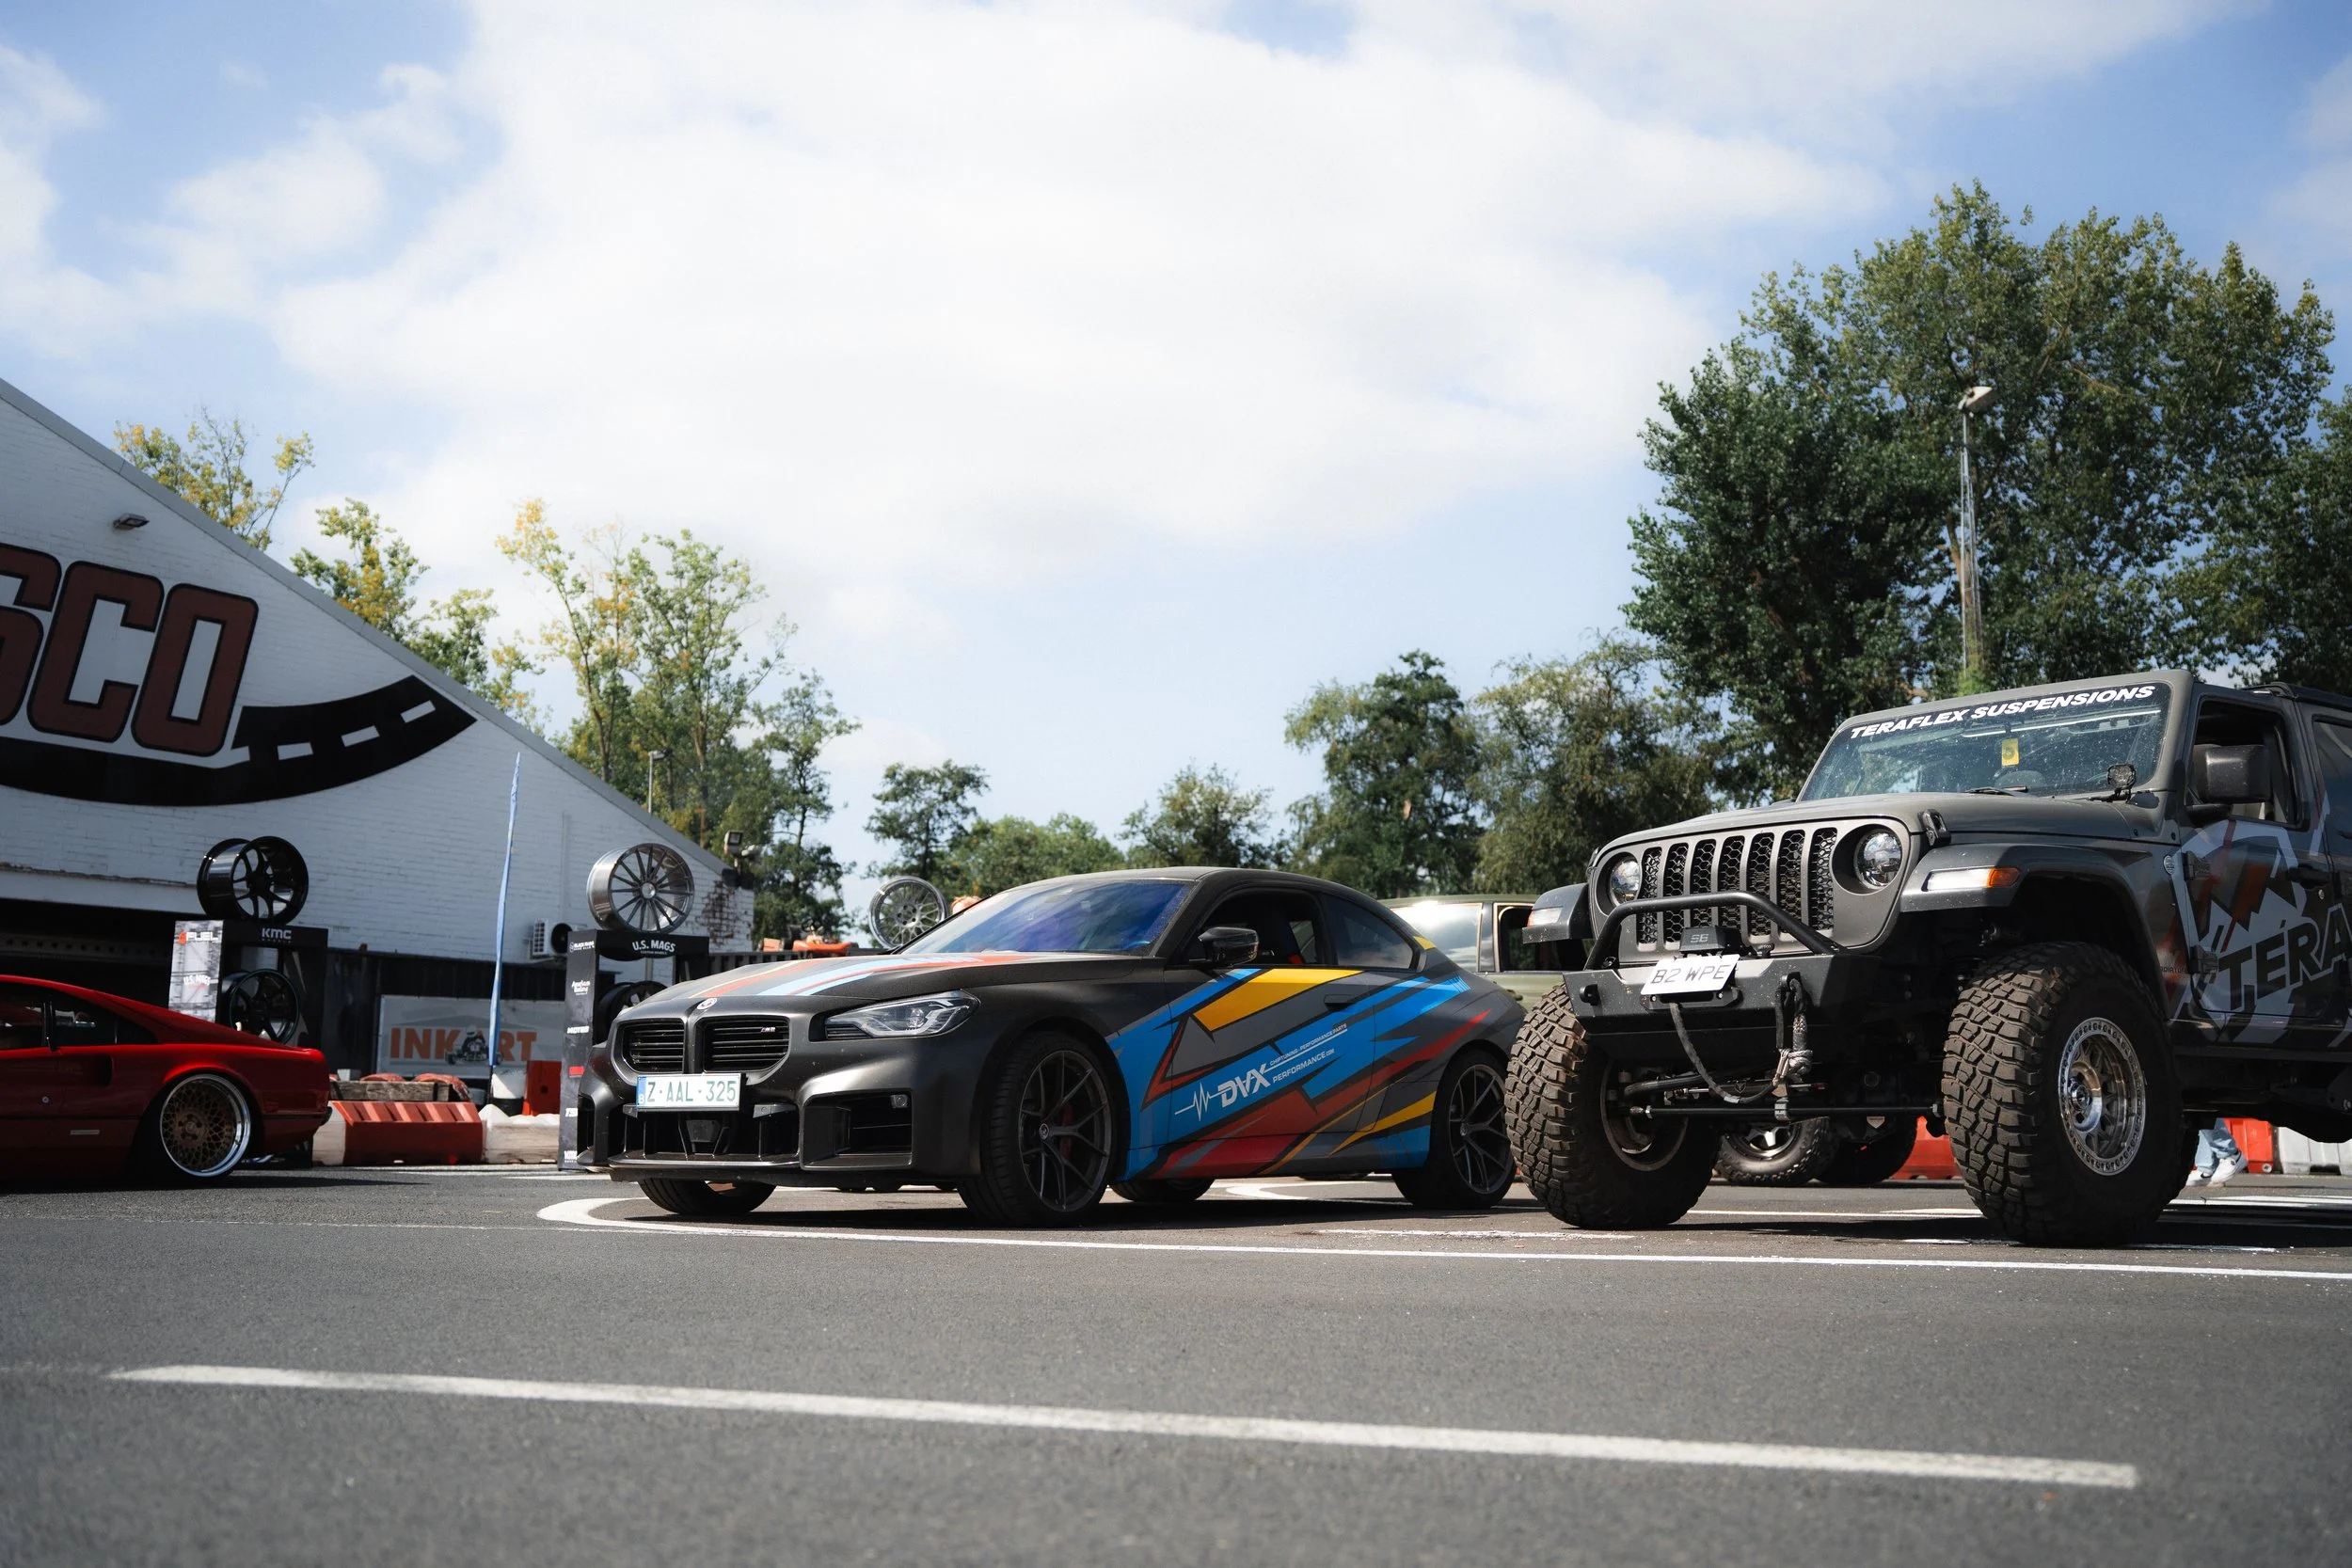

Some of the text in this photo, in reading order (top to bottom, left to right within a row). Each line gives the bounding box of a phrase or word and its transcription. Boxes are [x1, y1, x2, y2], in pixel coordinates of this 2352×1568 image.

[1851, 685, 2157, 739] TERAFLEX SUSPENSIONS
[186, 931, 218, 942] FUEL
[632, 940, 676, 953] U.S. MAGS
[1650, 964, 1731, 985] B2 WPE
[1332, 1023, 1347, 1035] PARTS
[1217, 1063, 1271, 1108] DVX
